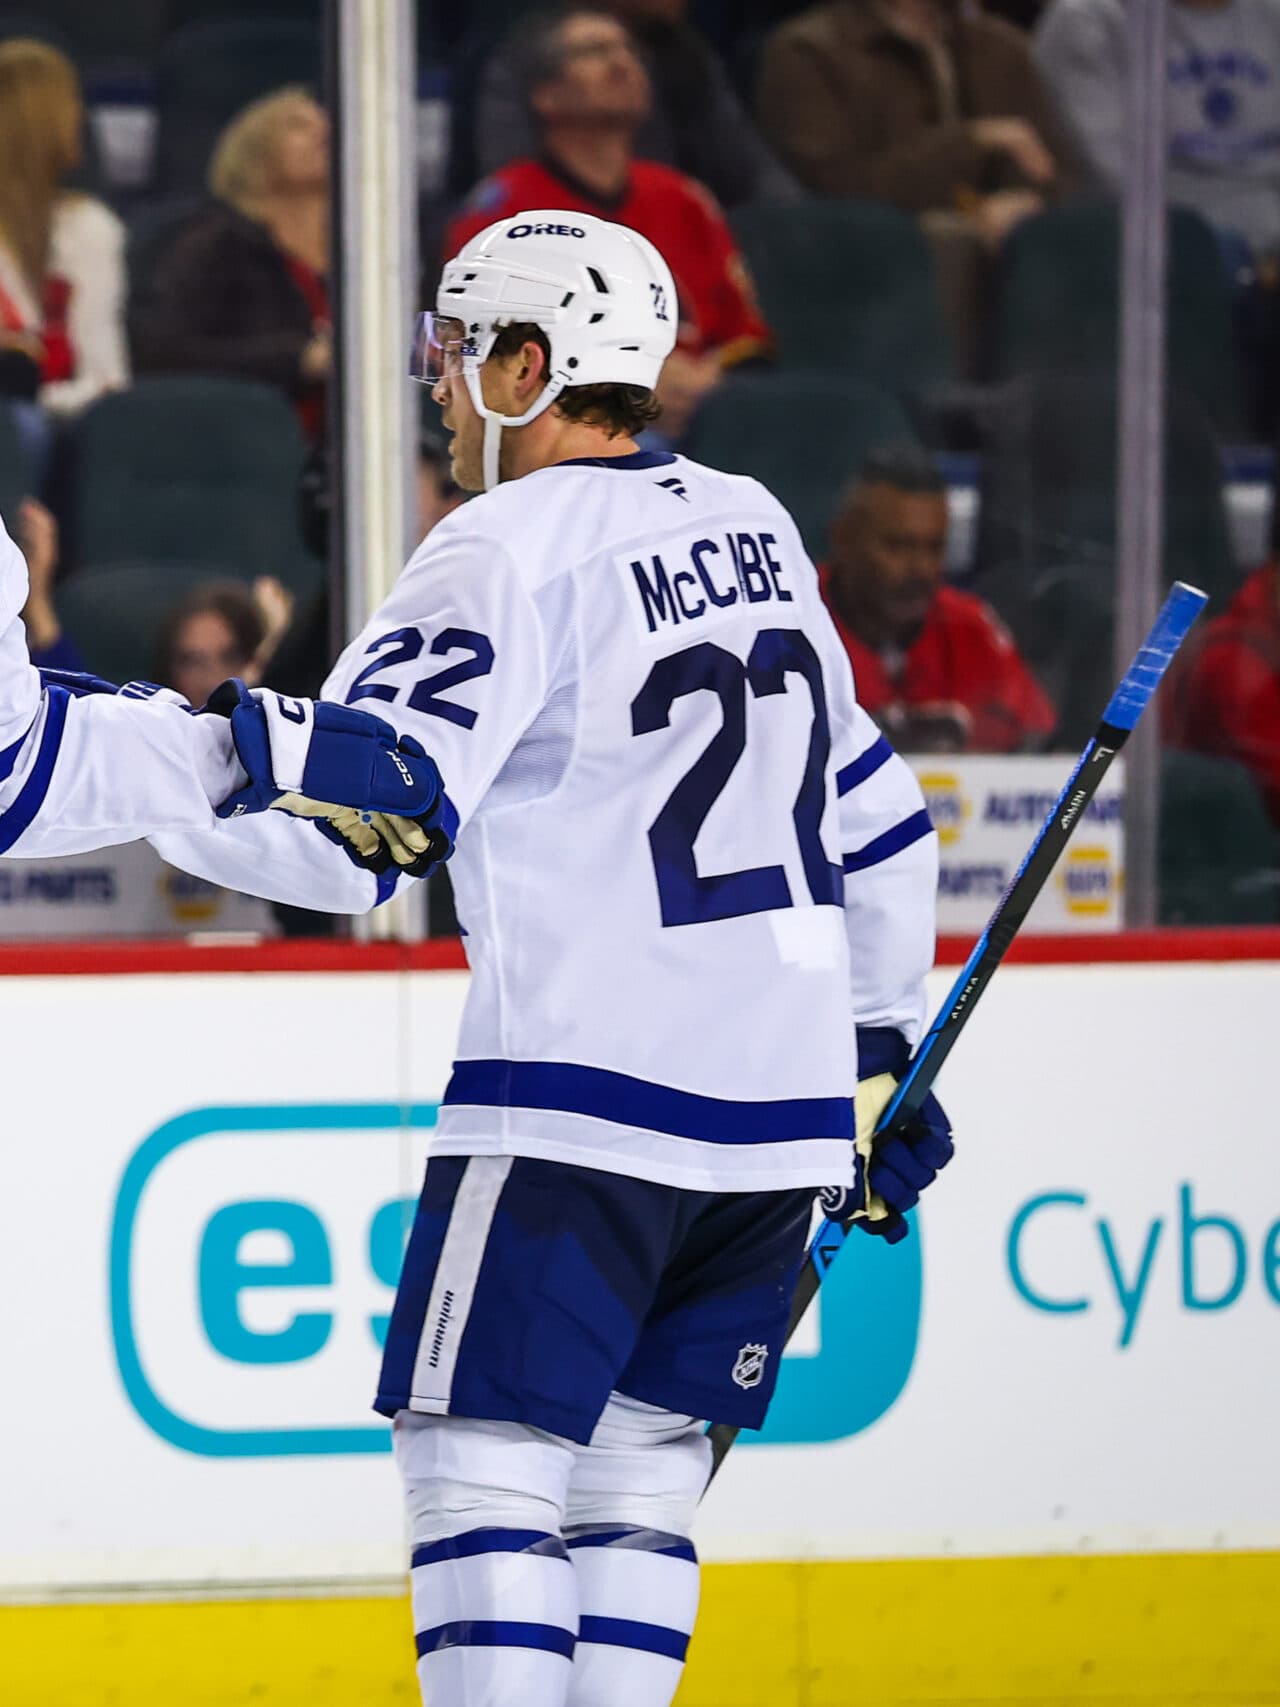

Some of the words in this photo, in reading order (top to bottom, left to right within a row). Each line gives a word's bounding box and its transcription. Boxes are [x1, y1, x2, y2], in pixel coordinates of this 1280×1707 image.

[506, 223, 586, 240] OREO
[344, 626, 496, 731] 22
[630, 626, 846, 929] 22
[1005, 1181, 1280, 1350] Cyb
